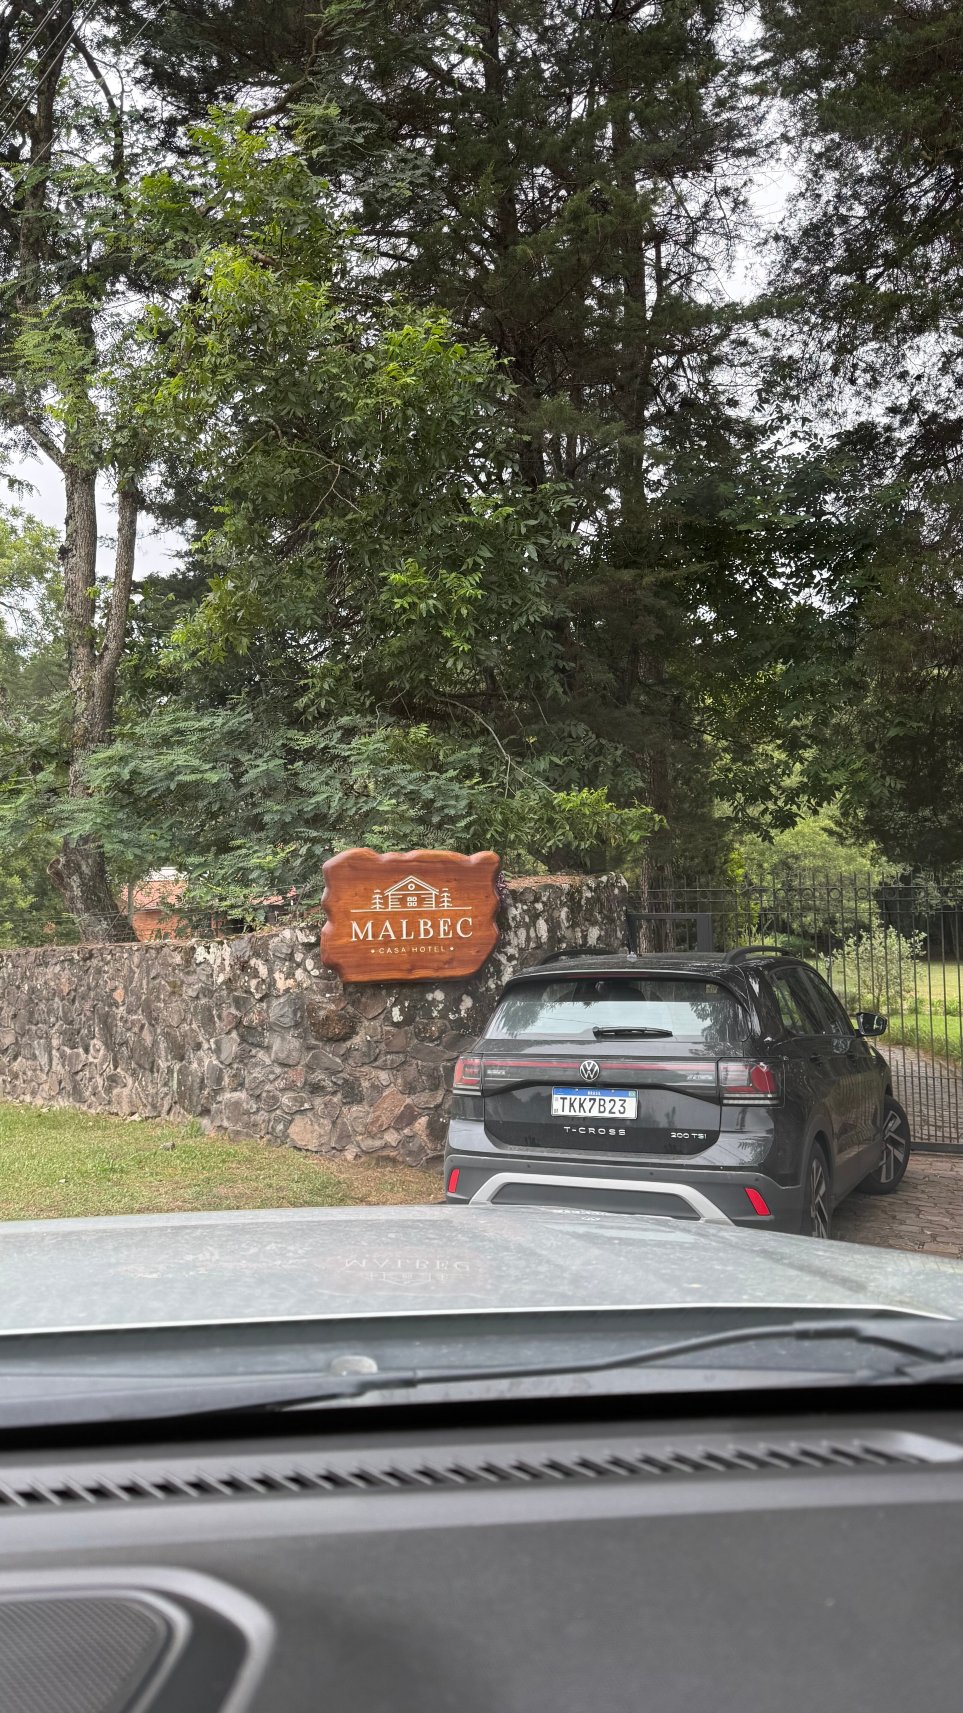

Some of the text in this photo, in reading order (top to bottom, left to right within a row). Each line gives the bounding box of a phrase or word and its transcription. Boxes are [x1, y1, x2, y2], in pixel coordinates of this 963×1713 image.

[350, 917, 473, 941] MALBEC
[411, 945, 446, 953] HOTEL
[559, 1096, 627, 1115] TKK7B23
[563, 1126, 626, 1136] T-CROSS
